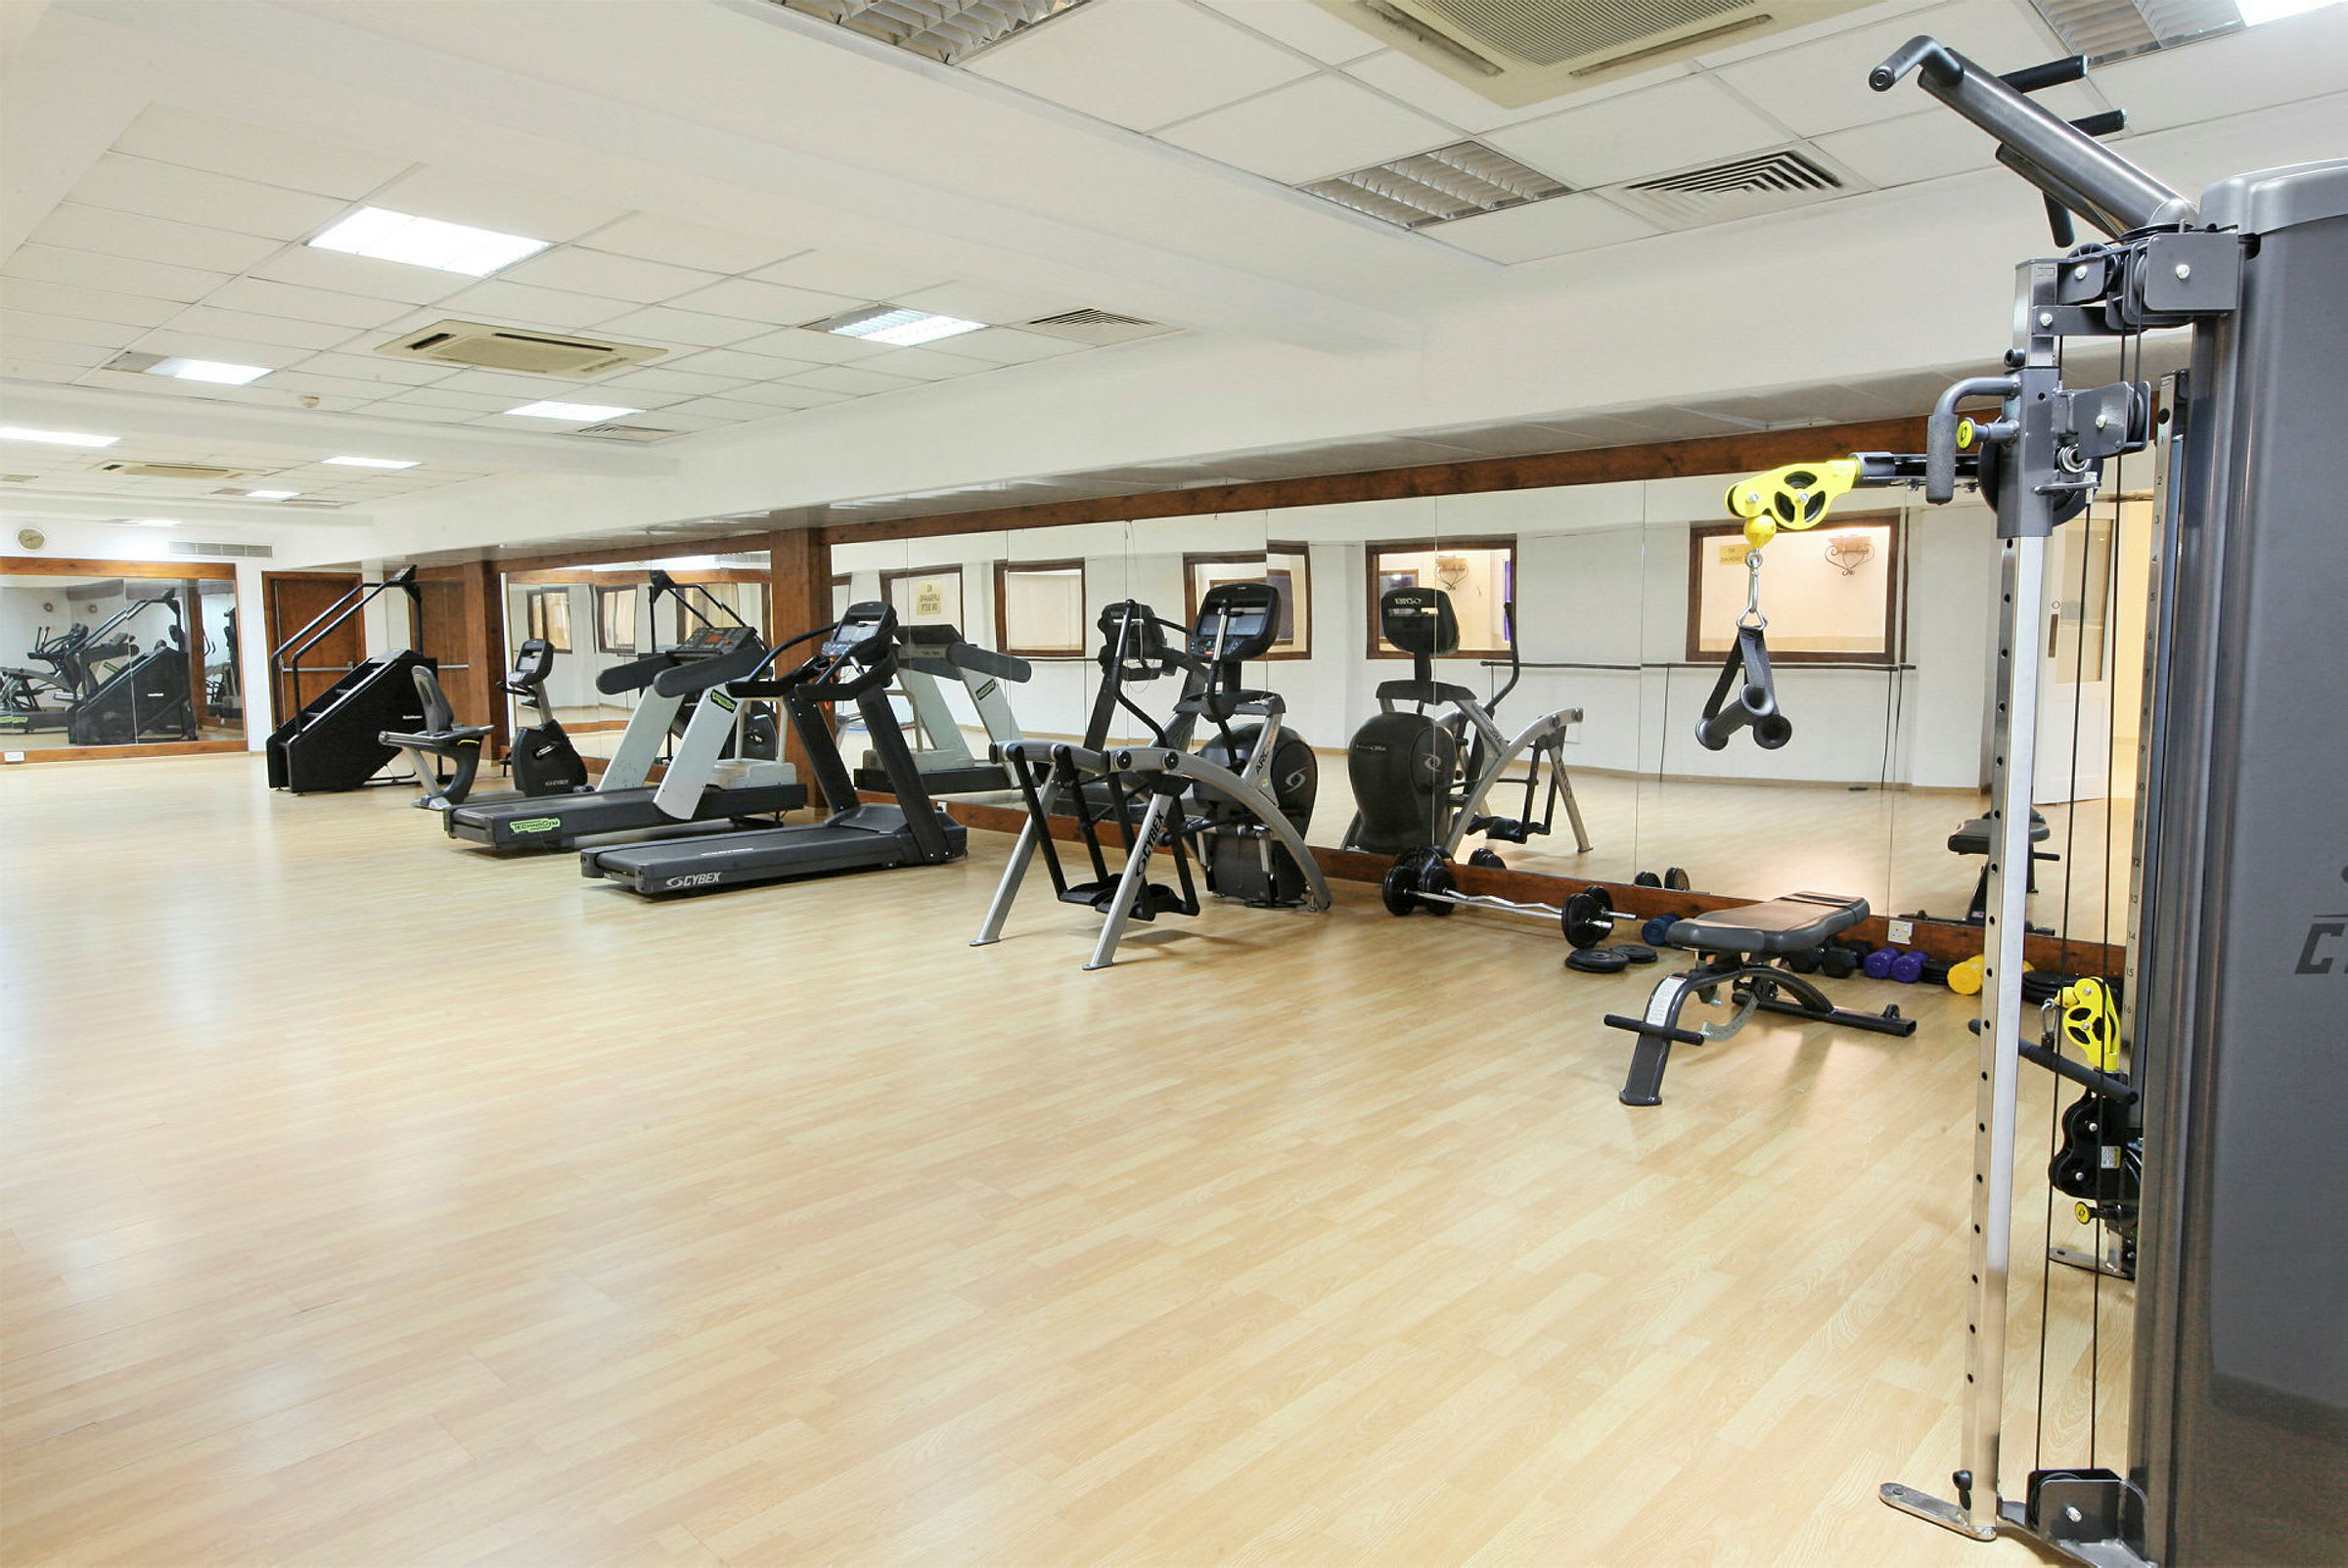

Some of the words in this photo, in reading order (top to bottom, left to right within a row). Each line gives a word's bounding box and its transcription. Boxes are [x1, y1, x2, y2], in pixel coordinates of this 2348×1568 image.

[1255, 750, 1270, 775] ARC
[1143, 809, 1164, 859] CYBEX
[683, 872, 722, 887] CYBEX
[2294, 922, 2348, 974] C
